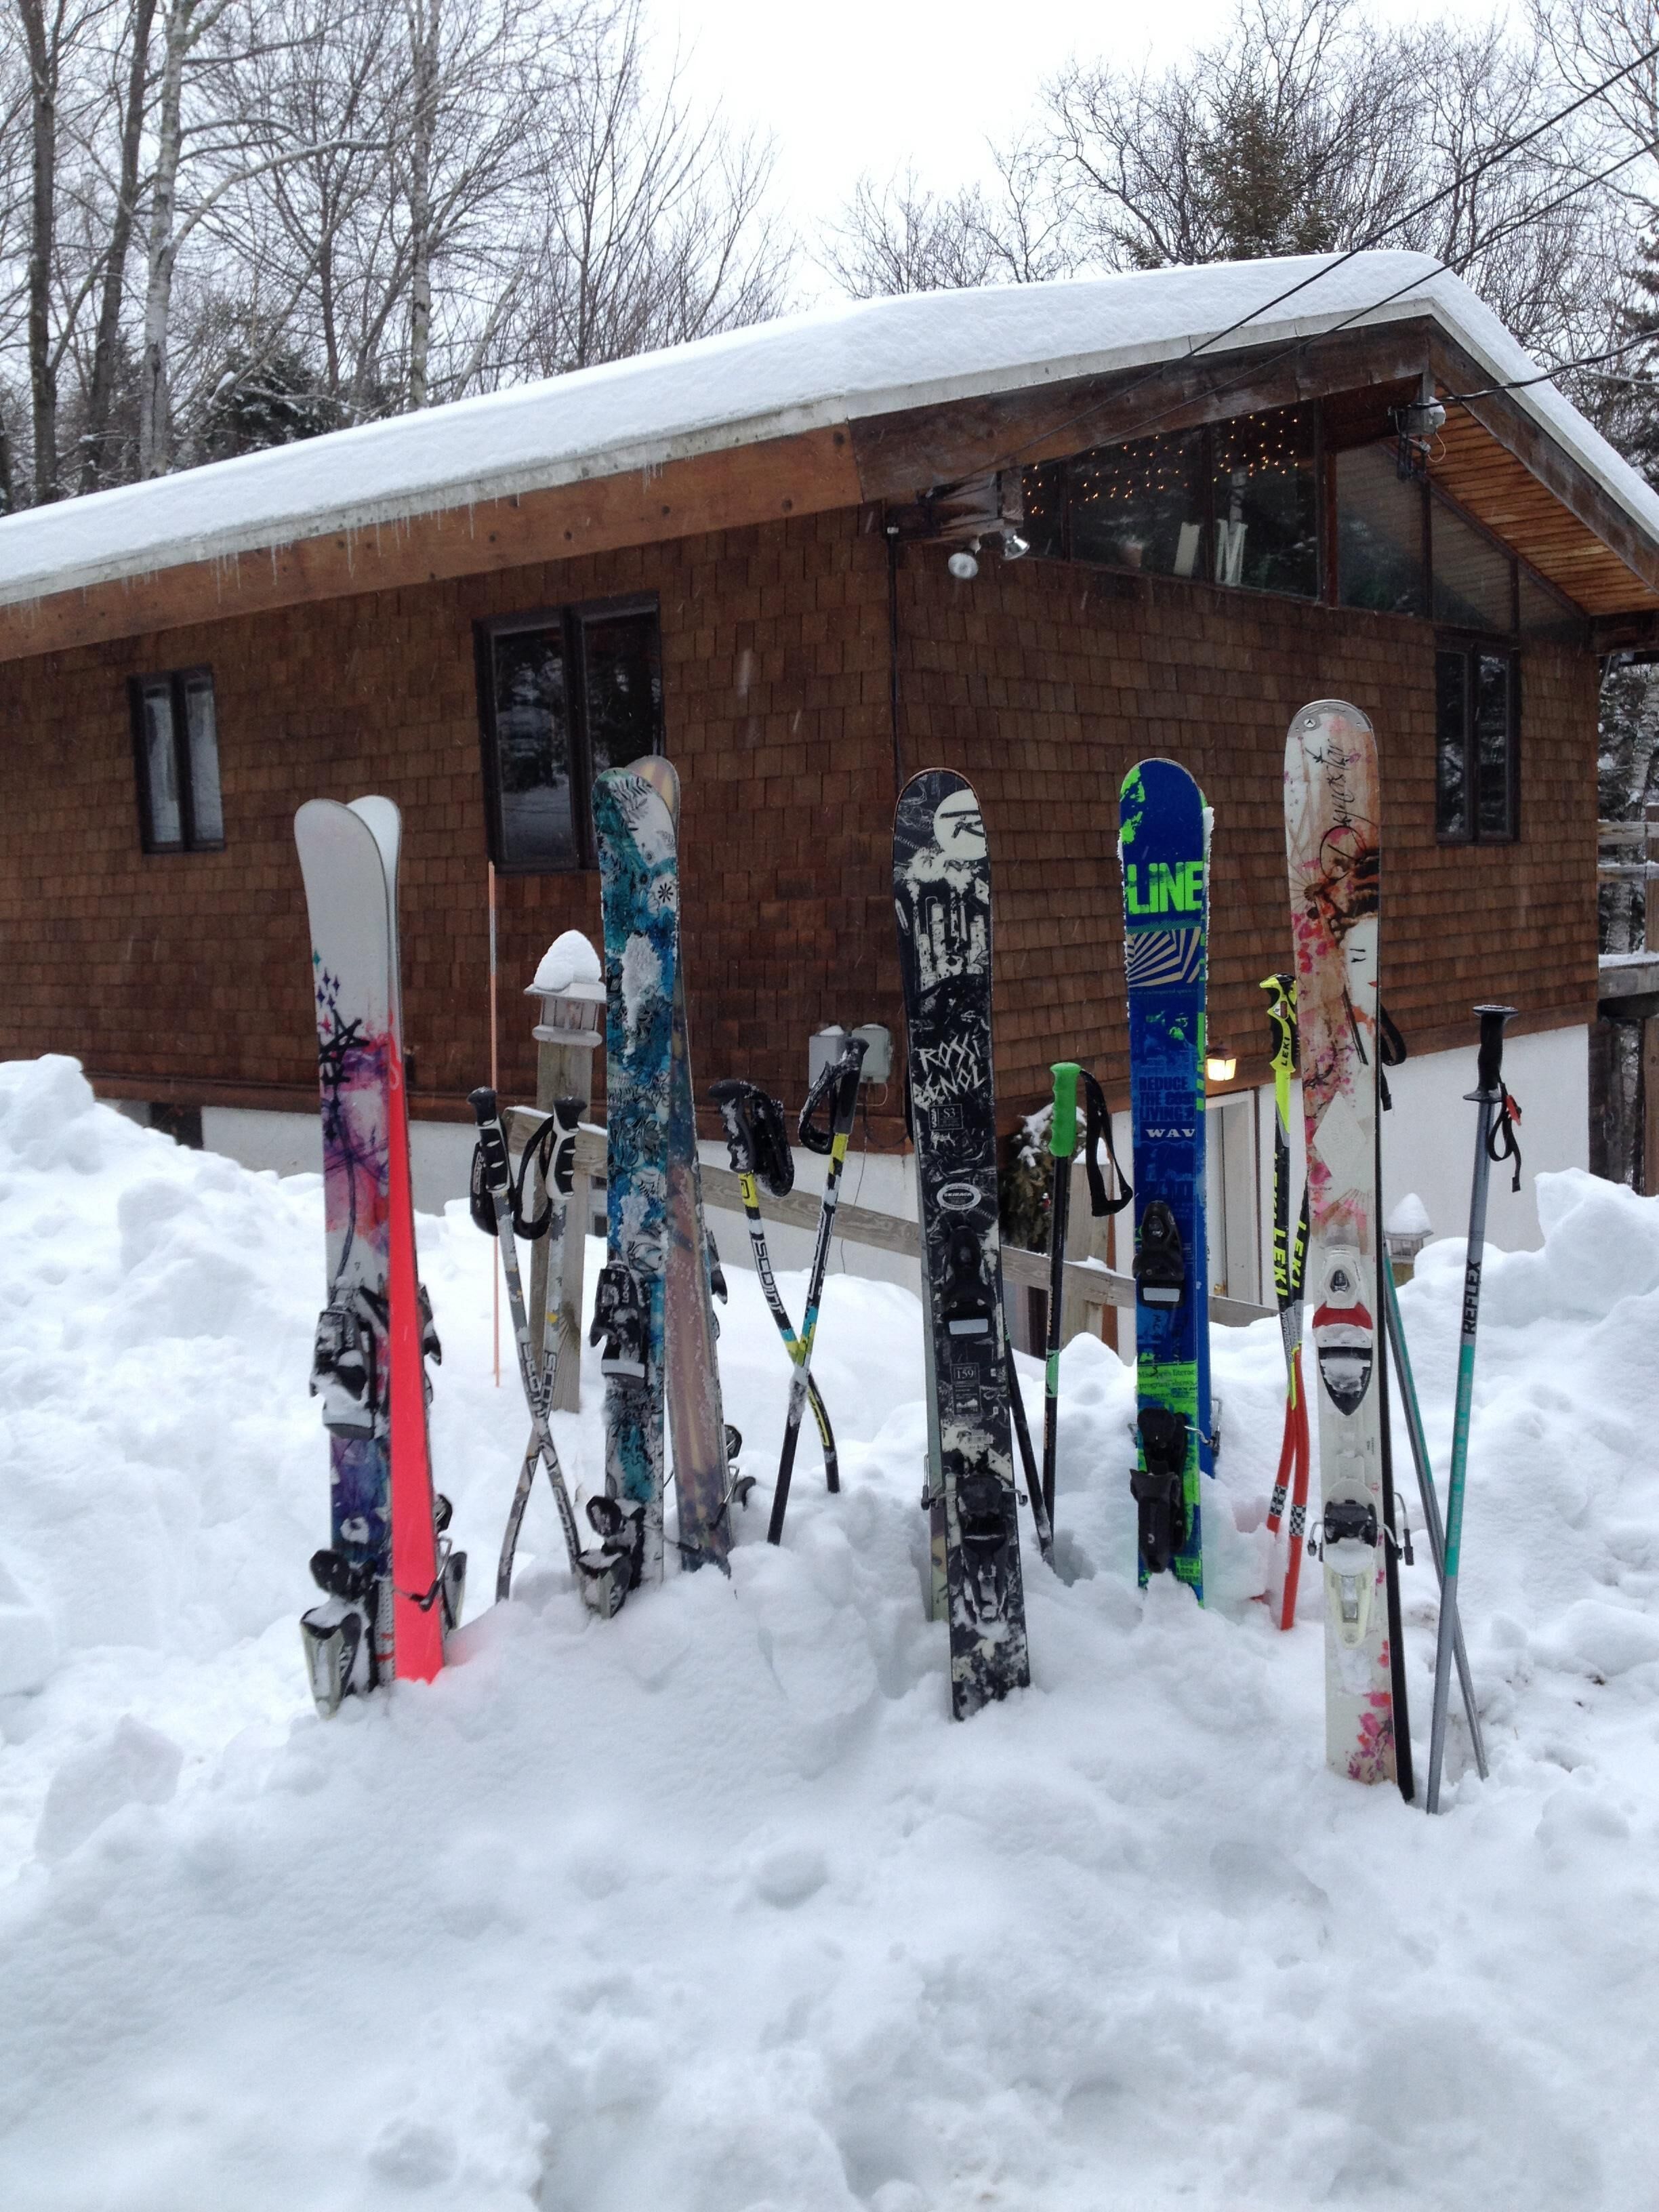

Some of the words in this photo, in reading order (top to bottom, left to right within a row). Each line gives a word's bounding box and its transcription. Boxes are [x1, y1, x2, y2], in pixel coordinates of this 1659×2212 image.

[915, 1031, 981, 1076] ROSSI
[1281, 1037, 1290, 1067] LEKI
[1139, 1076, 1188, 1091] REDUCE
[1140, 1091, 1162, 1105] THE
[1273, 1227, 1288, 1296] LEKI
[1291, 1220, 1307, 1288] LEKI
[754, 1242, 785, 1314] SCOTT
[1462, 1259, 1481, 1335] REFLEX
[957, 1369, 975, 1380] 159
